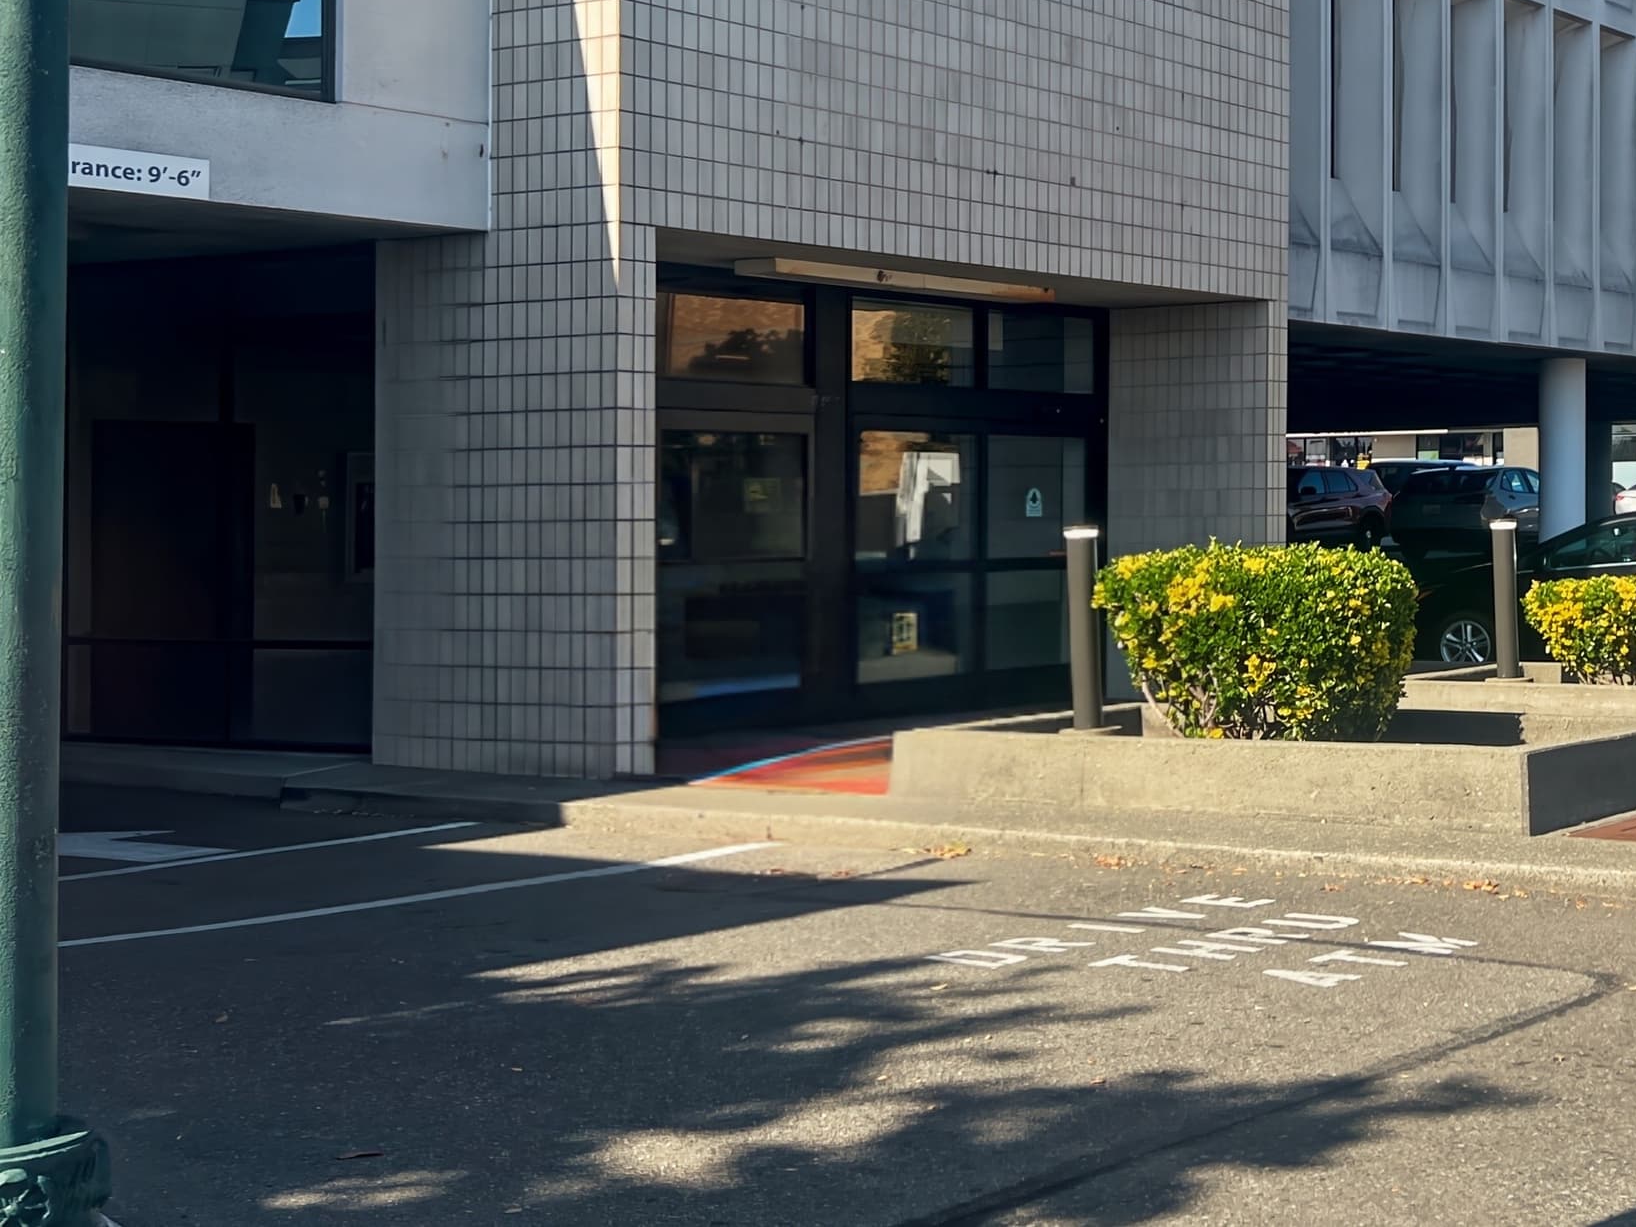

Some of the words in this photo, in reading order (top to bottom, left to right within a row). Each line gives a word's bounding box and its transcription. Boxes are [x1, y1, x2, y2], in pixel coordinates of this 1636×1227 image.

[925, 894, 1276, 969] DRIVE
[1088, 912, 1360, 973] THRU
[1262, 931, 1479, 988] ATM
